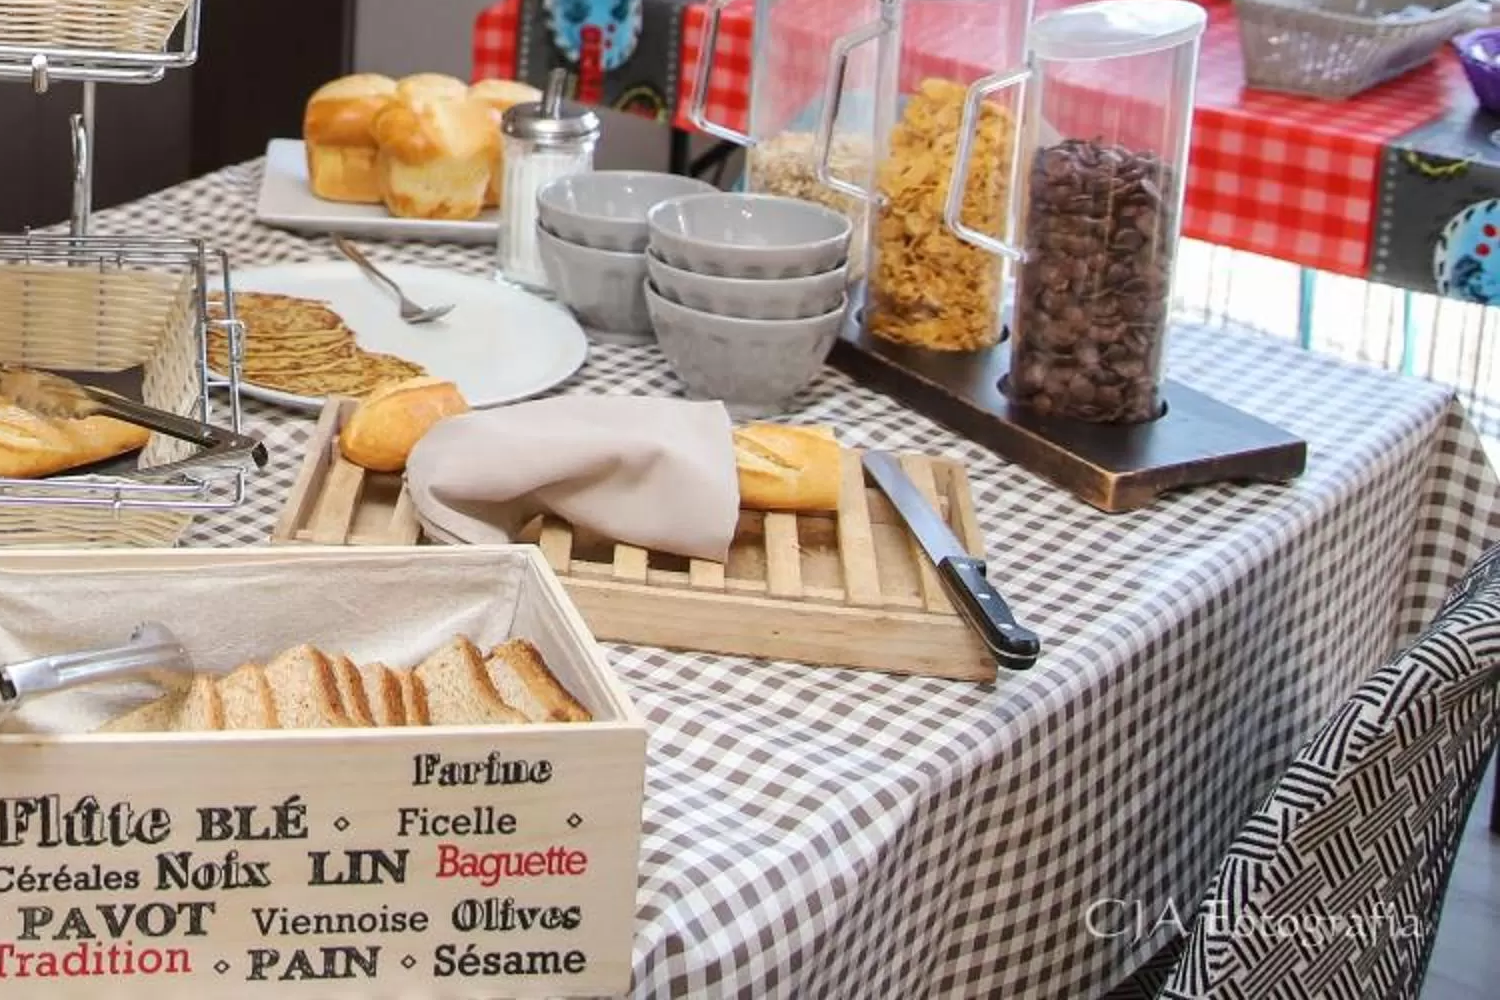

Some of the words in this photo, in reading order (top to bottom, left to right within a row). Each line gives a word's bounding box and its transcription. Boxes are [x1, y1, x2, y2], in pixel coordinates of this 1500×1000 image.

[412, 750, 553, 787] Farine
[196, 796, 308, 842] BLÉ
[397, 806, 517, 837] Ficelle
[155, 849, 272, 891] Noix
[307, 848, 409, 886] LIN
[435, 844, 588, 887] Baguette
[17, 902, 216, 941] PAVOT
[252, 905, 429, 936] Viennoise
[451, 897, 581, 933] Olives
[246, 946, 381, 981] PAIN
[434, 943, 587, 977] Sésame
